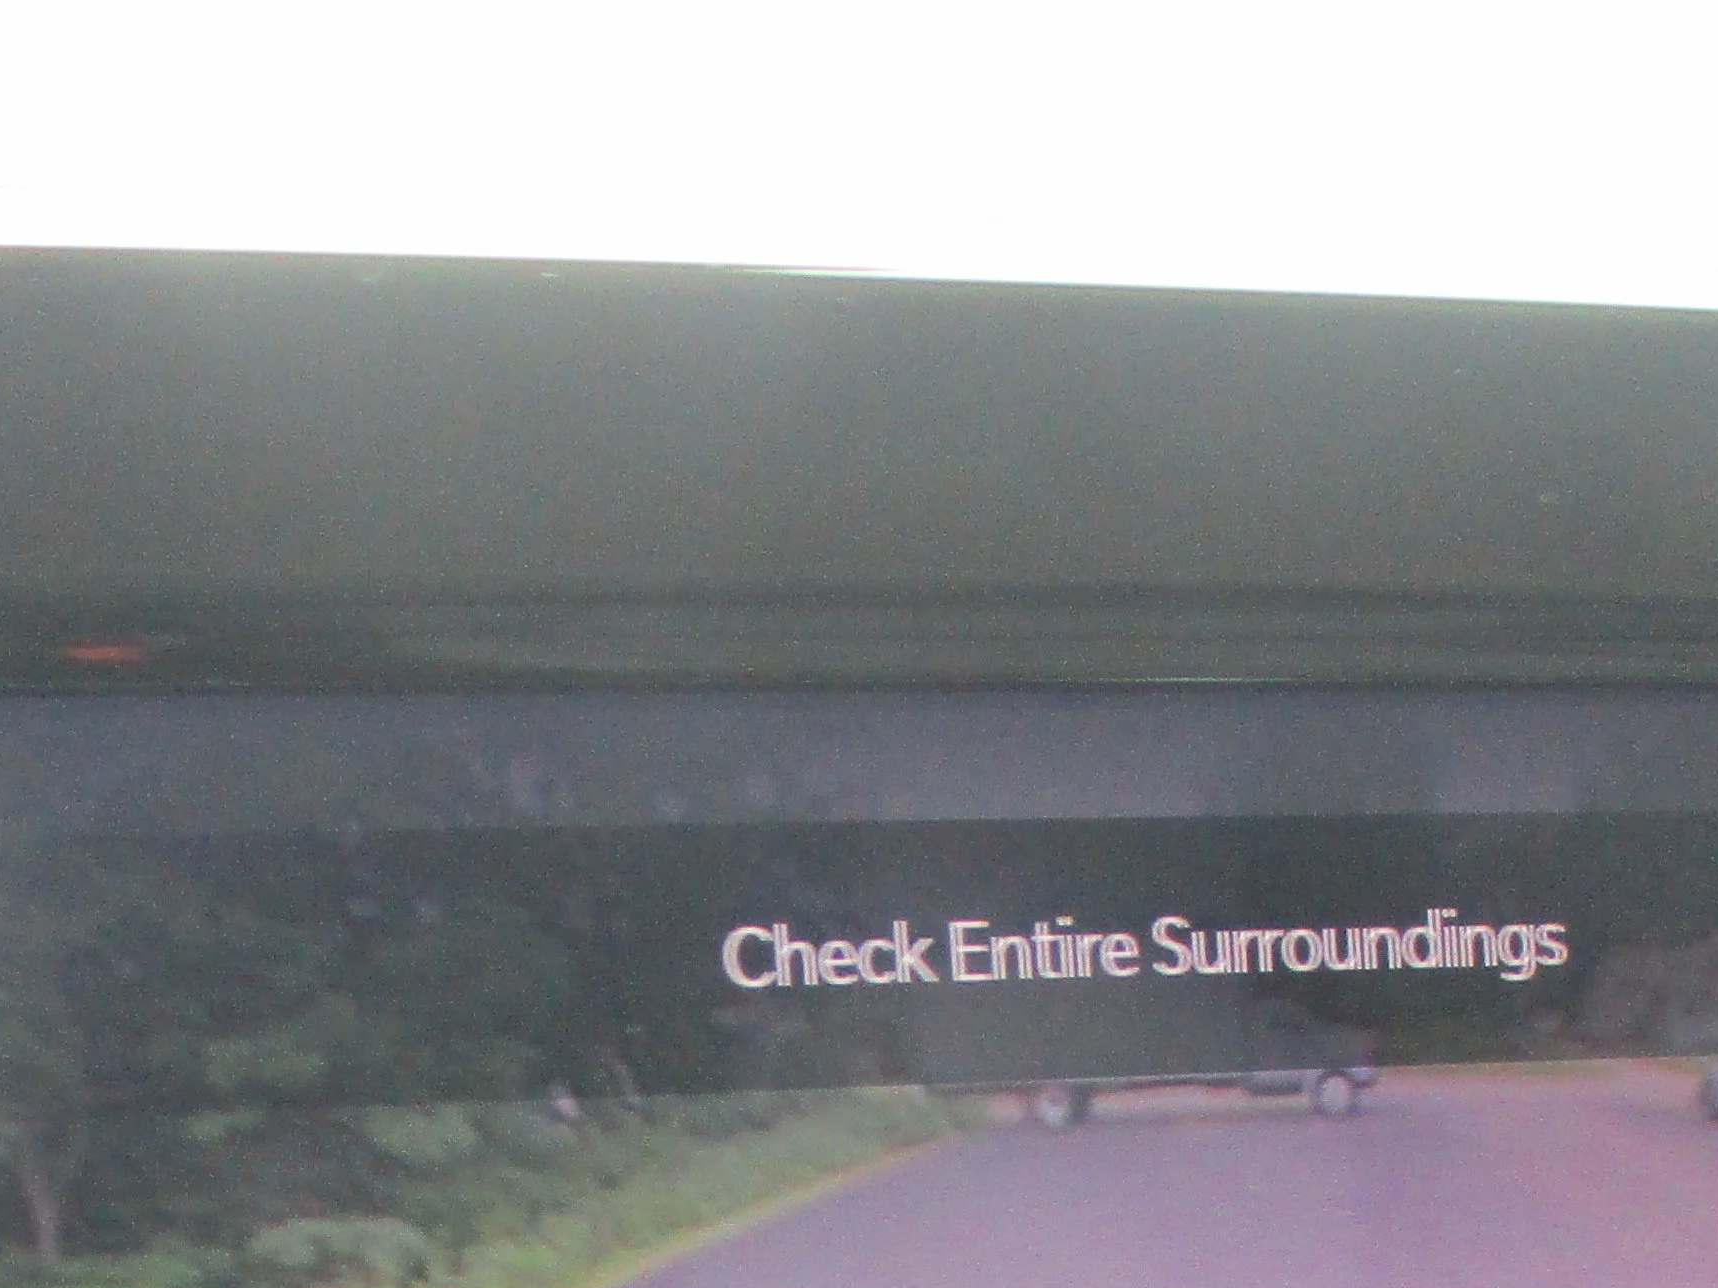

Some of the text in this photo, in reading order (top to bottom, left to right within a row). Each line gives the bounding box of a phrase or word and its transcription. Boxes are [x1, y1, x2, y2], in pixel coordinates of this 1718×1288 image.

[721, 907, 1569, 989] Check Entire Surroundings
